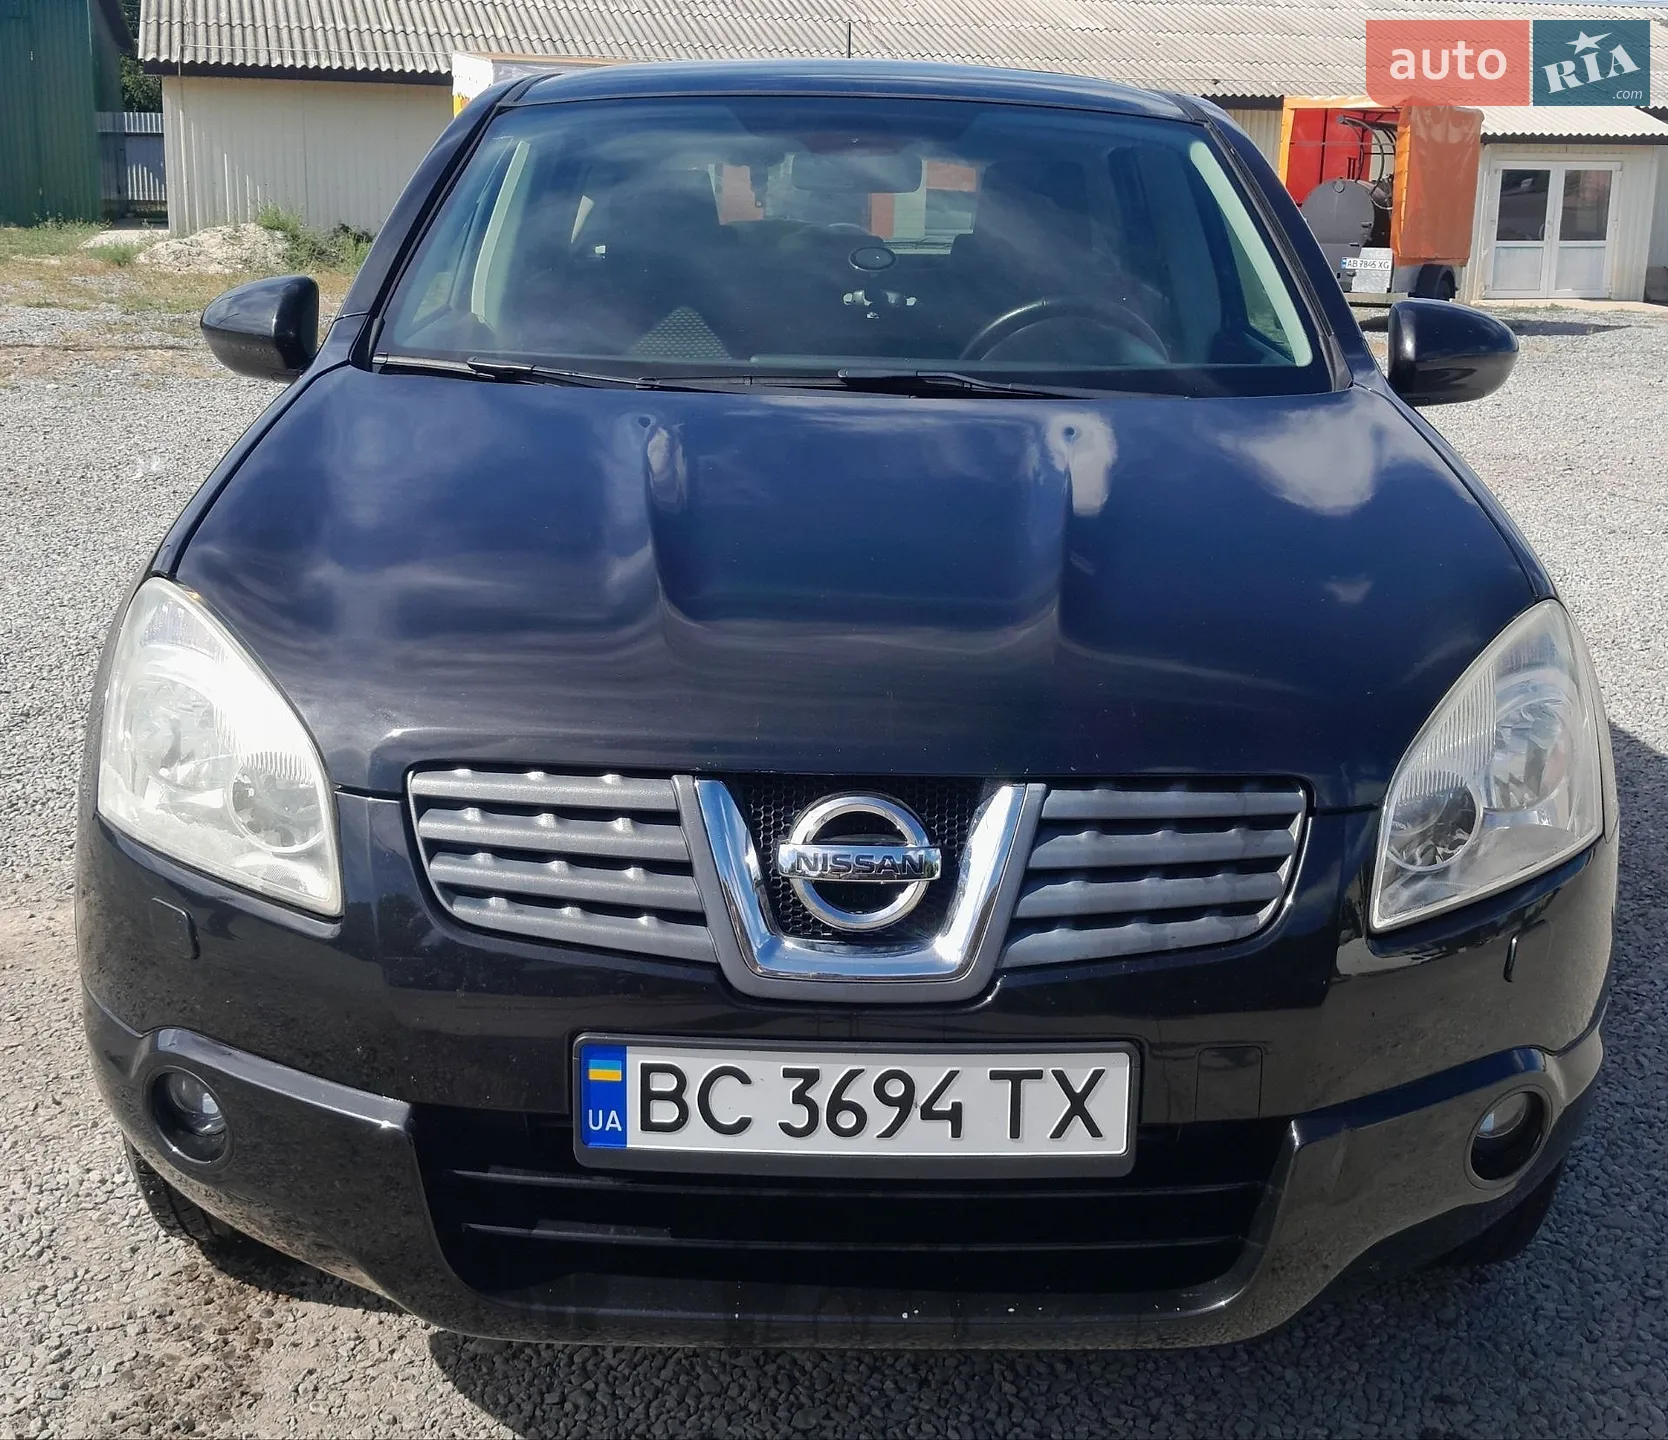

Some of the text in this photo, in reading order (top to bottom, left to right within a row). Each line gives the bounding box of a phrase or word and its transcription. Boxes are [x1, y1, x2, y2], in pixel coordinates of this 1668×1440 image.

[1347, 260, 1358, 268] AB
[796, 852, 924, 875] NISSAN
[640, 1062, 1107, 1140] BC 3694 TX
[588, 1109, 622, 1132] UA
